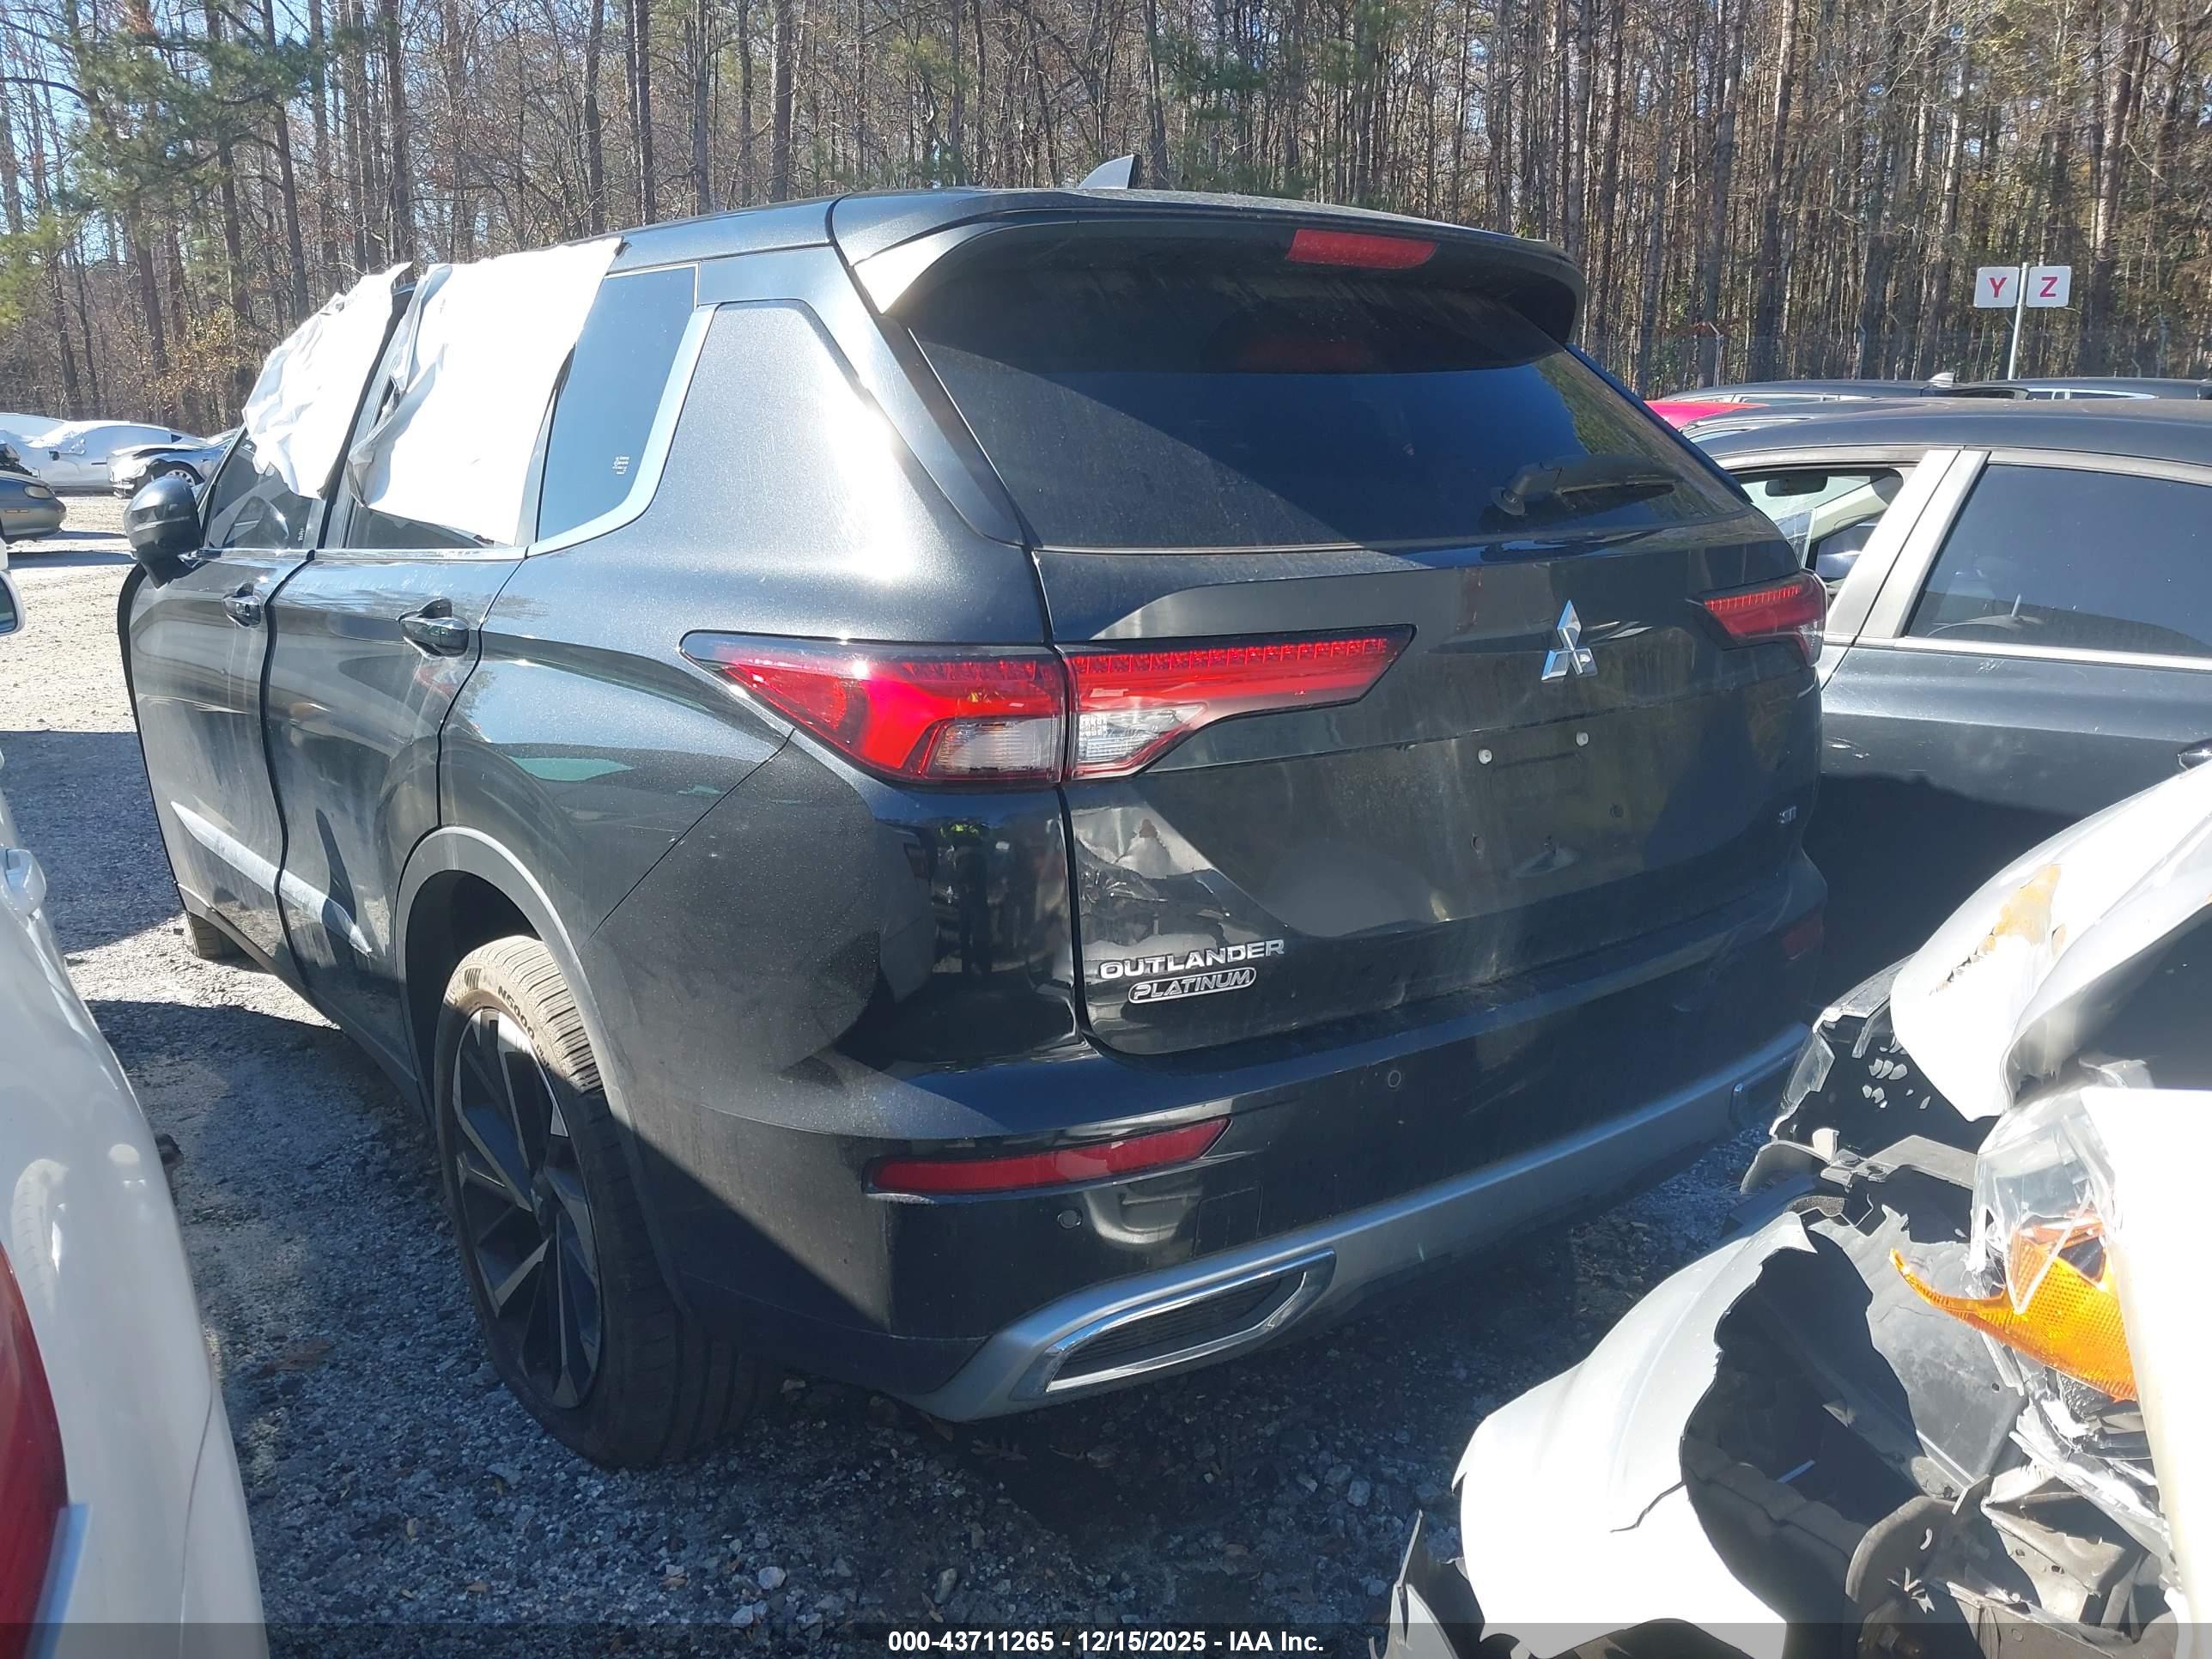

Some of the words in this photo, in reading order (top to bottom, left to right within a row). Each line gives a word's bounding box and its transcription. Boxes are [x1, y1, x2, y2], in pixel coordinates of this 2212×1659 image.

[1989, 276, 2008, 298] Y
[2039, 276, 2058, 297] Z
[1100, 939, 1285, 980] OUTLANDER
[1133, 969, 1250, 1000] PLATINUM
[497, 985, 535, 1041] N5000
